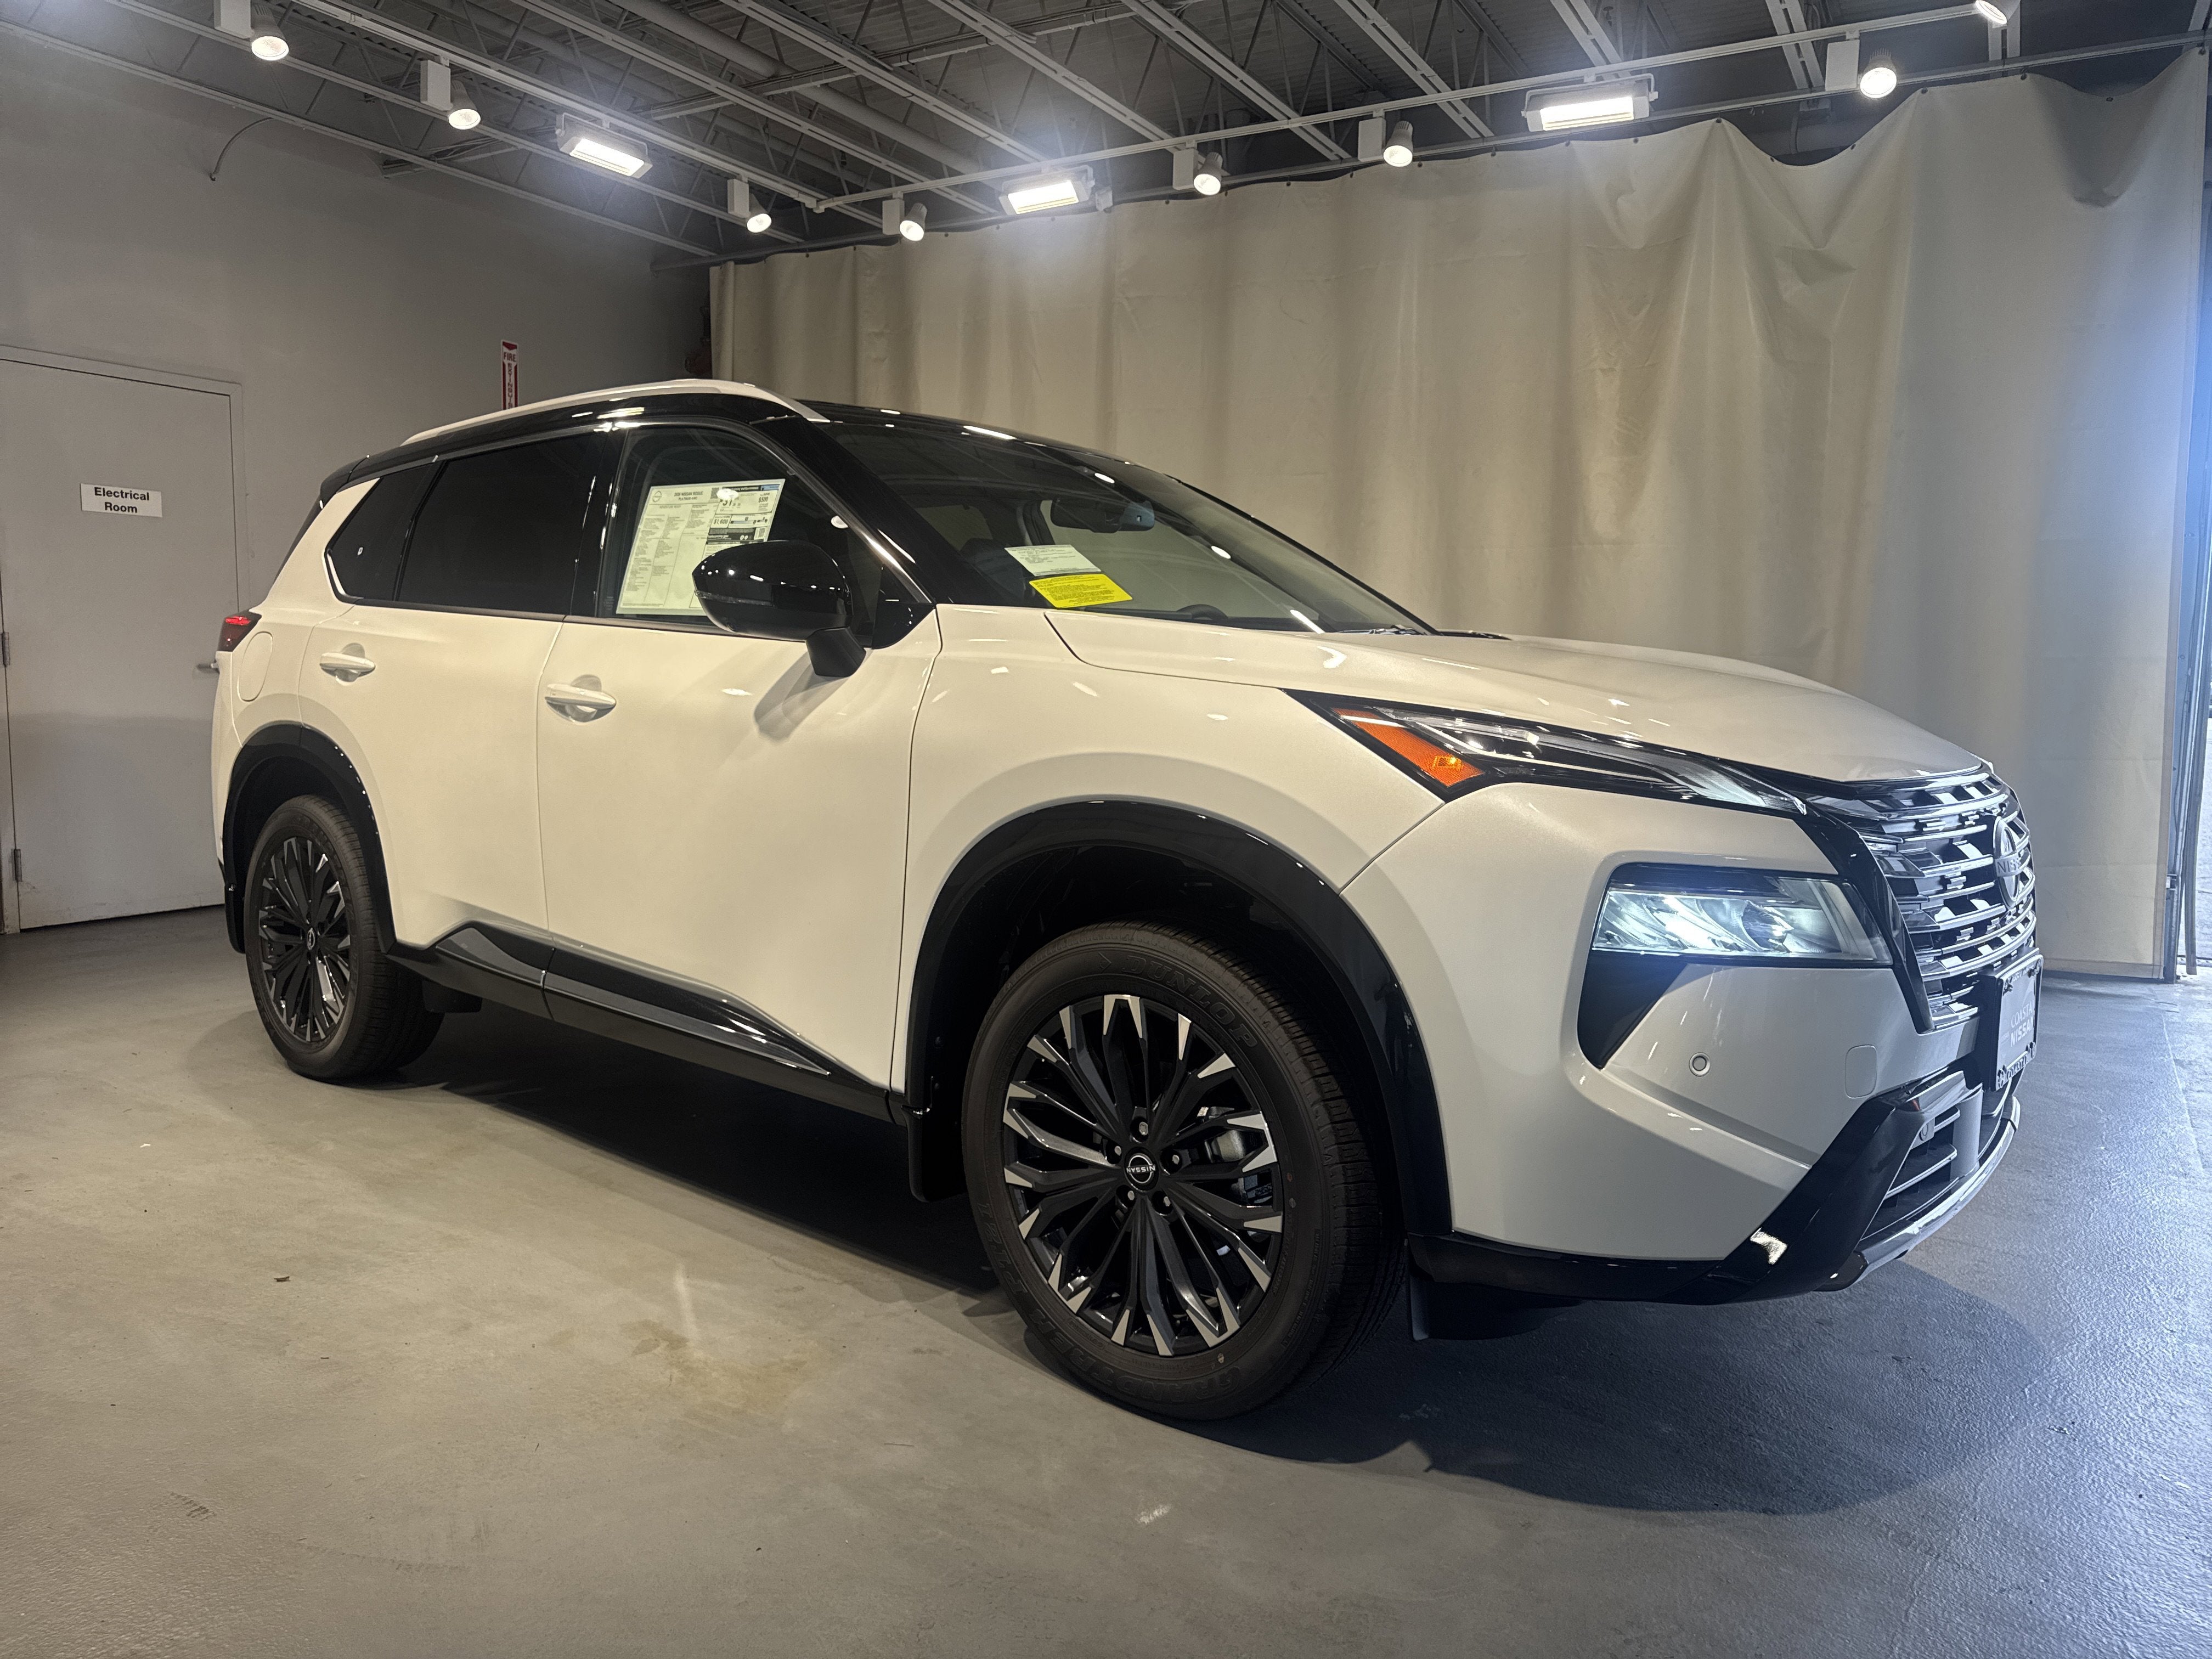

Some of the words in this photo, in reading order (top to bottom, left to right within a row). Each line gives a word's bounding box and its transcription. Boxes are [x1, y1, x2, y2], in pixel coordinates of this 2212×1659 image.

[504, 352, 516, 362] FIRE
[94, 487, 150, 501] Electrical
[105, 501, 138, 514] Room
[1121, 955, 1257, 1047] DUNLOP
[2010, 1016, 2033, 1047] NISSAN
